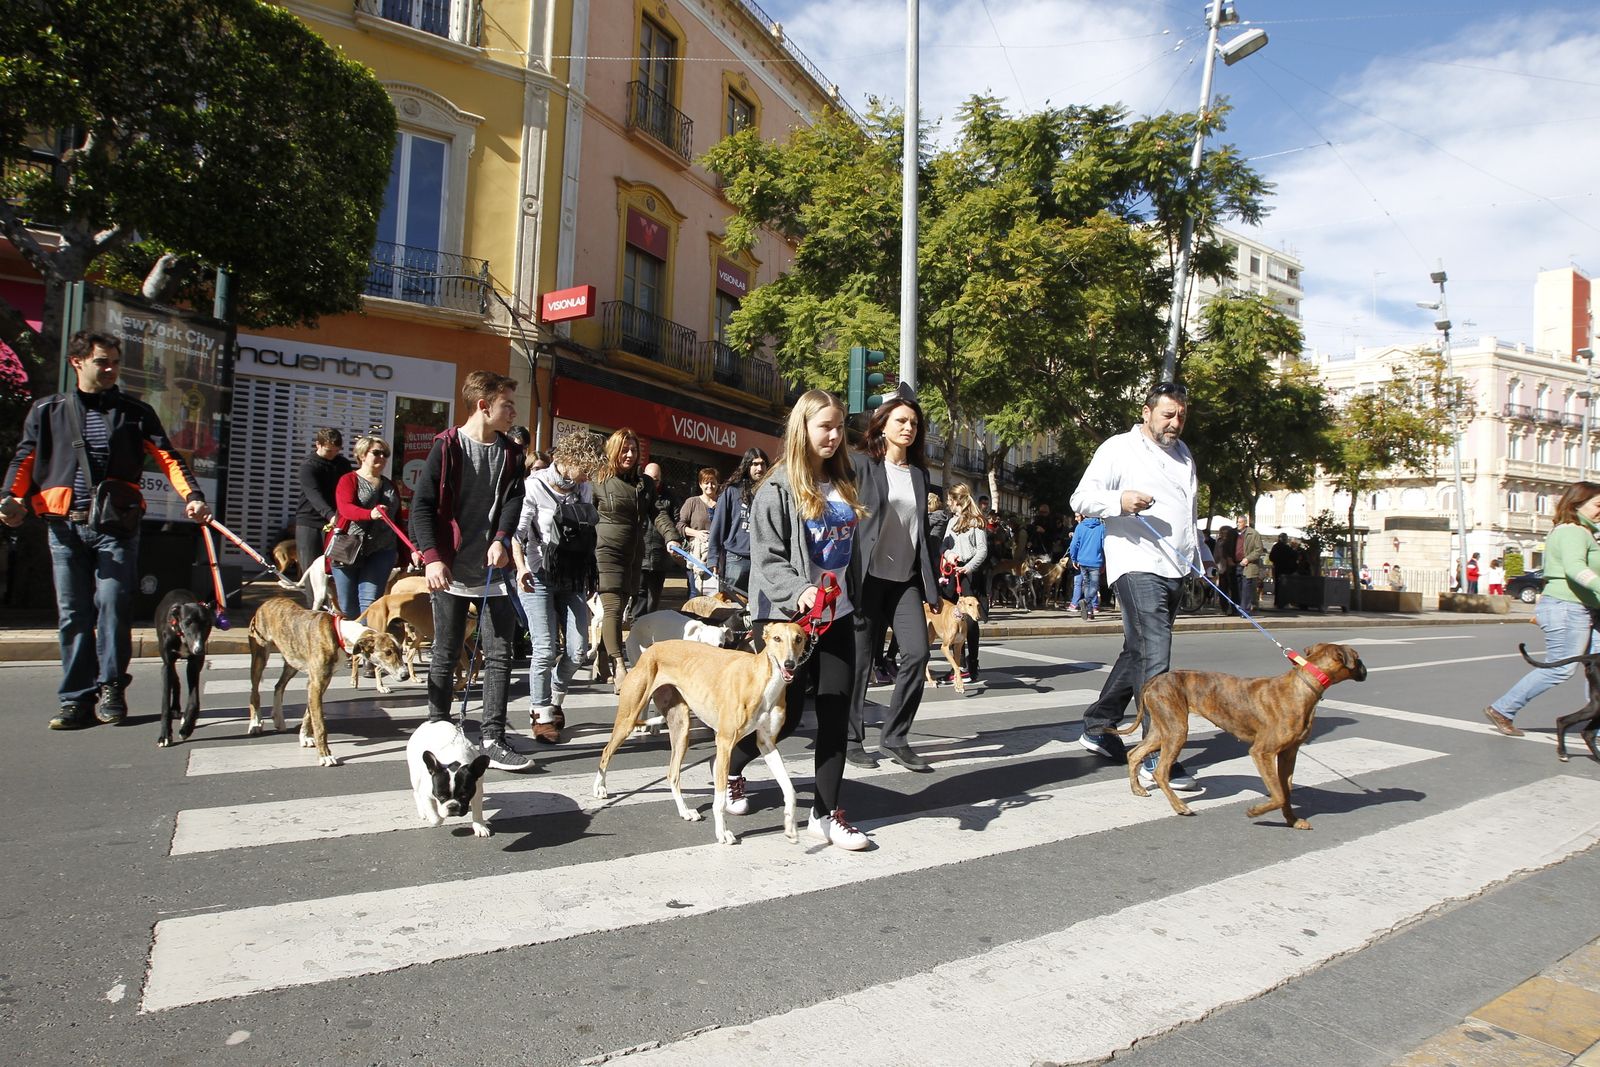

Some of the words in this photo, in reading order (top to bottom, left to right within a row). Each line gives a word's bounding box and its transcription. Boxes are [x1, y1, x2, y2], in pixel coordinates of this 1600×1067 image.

[719, 269, 745, 290] VISIONLAB
[548, 296, 586, 311] VISIONLAB
[108, 309, 147, 332] New
[148, 320, 182, 341] York
[185, 330, 215, 350] City
[112, 329, 157, 346] Conócela
[157, 341, 173, 351] por
[235, 345, 393, 380] ncuentro
[671, 415, 737, 448] VISIONLAB
[809, 525, 851, 543] NAS
